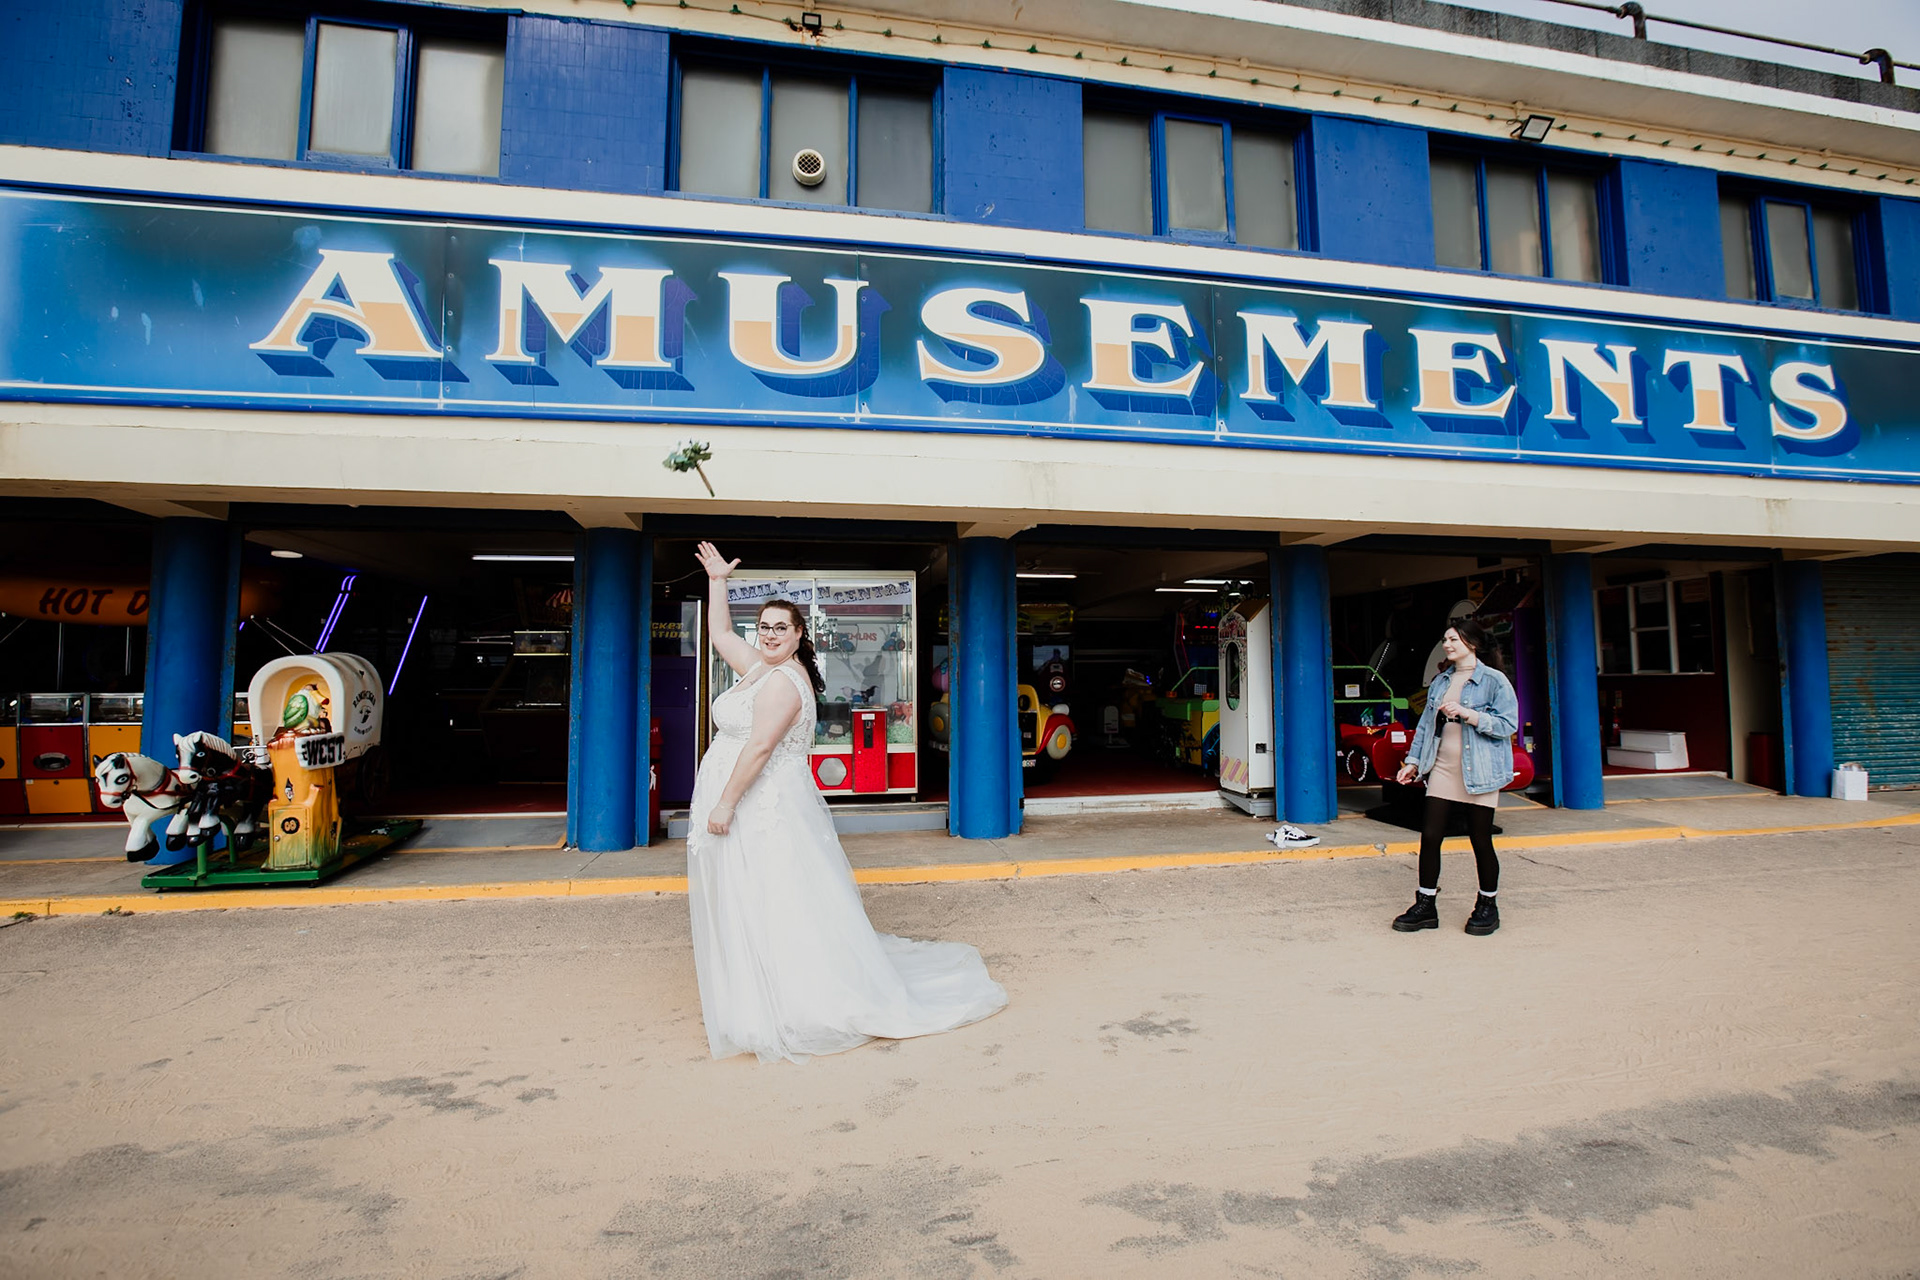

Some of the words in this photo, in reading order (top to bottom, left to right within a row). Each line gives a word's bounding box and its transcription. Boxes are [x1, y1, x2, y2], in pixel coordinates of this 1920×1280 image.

[249, 248, 1850, 443] AMUSEMENTS
[38, 587, 113, 615] HOT
[727, 579, 790, 603] AMILY
[789, 586, 831, 604] FUN
[832, 580, 911, 605] CENTRE
[651, 621, 684, 630] CKET
